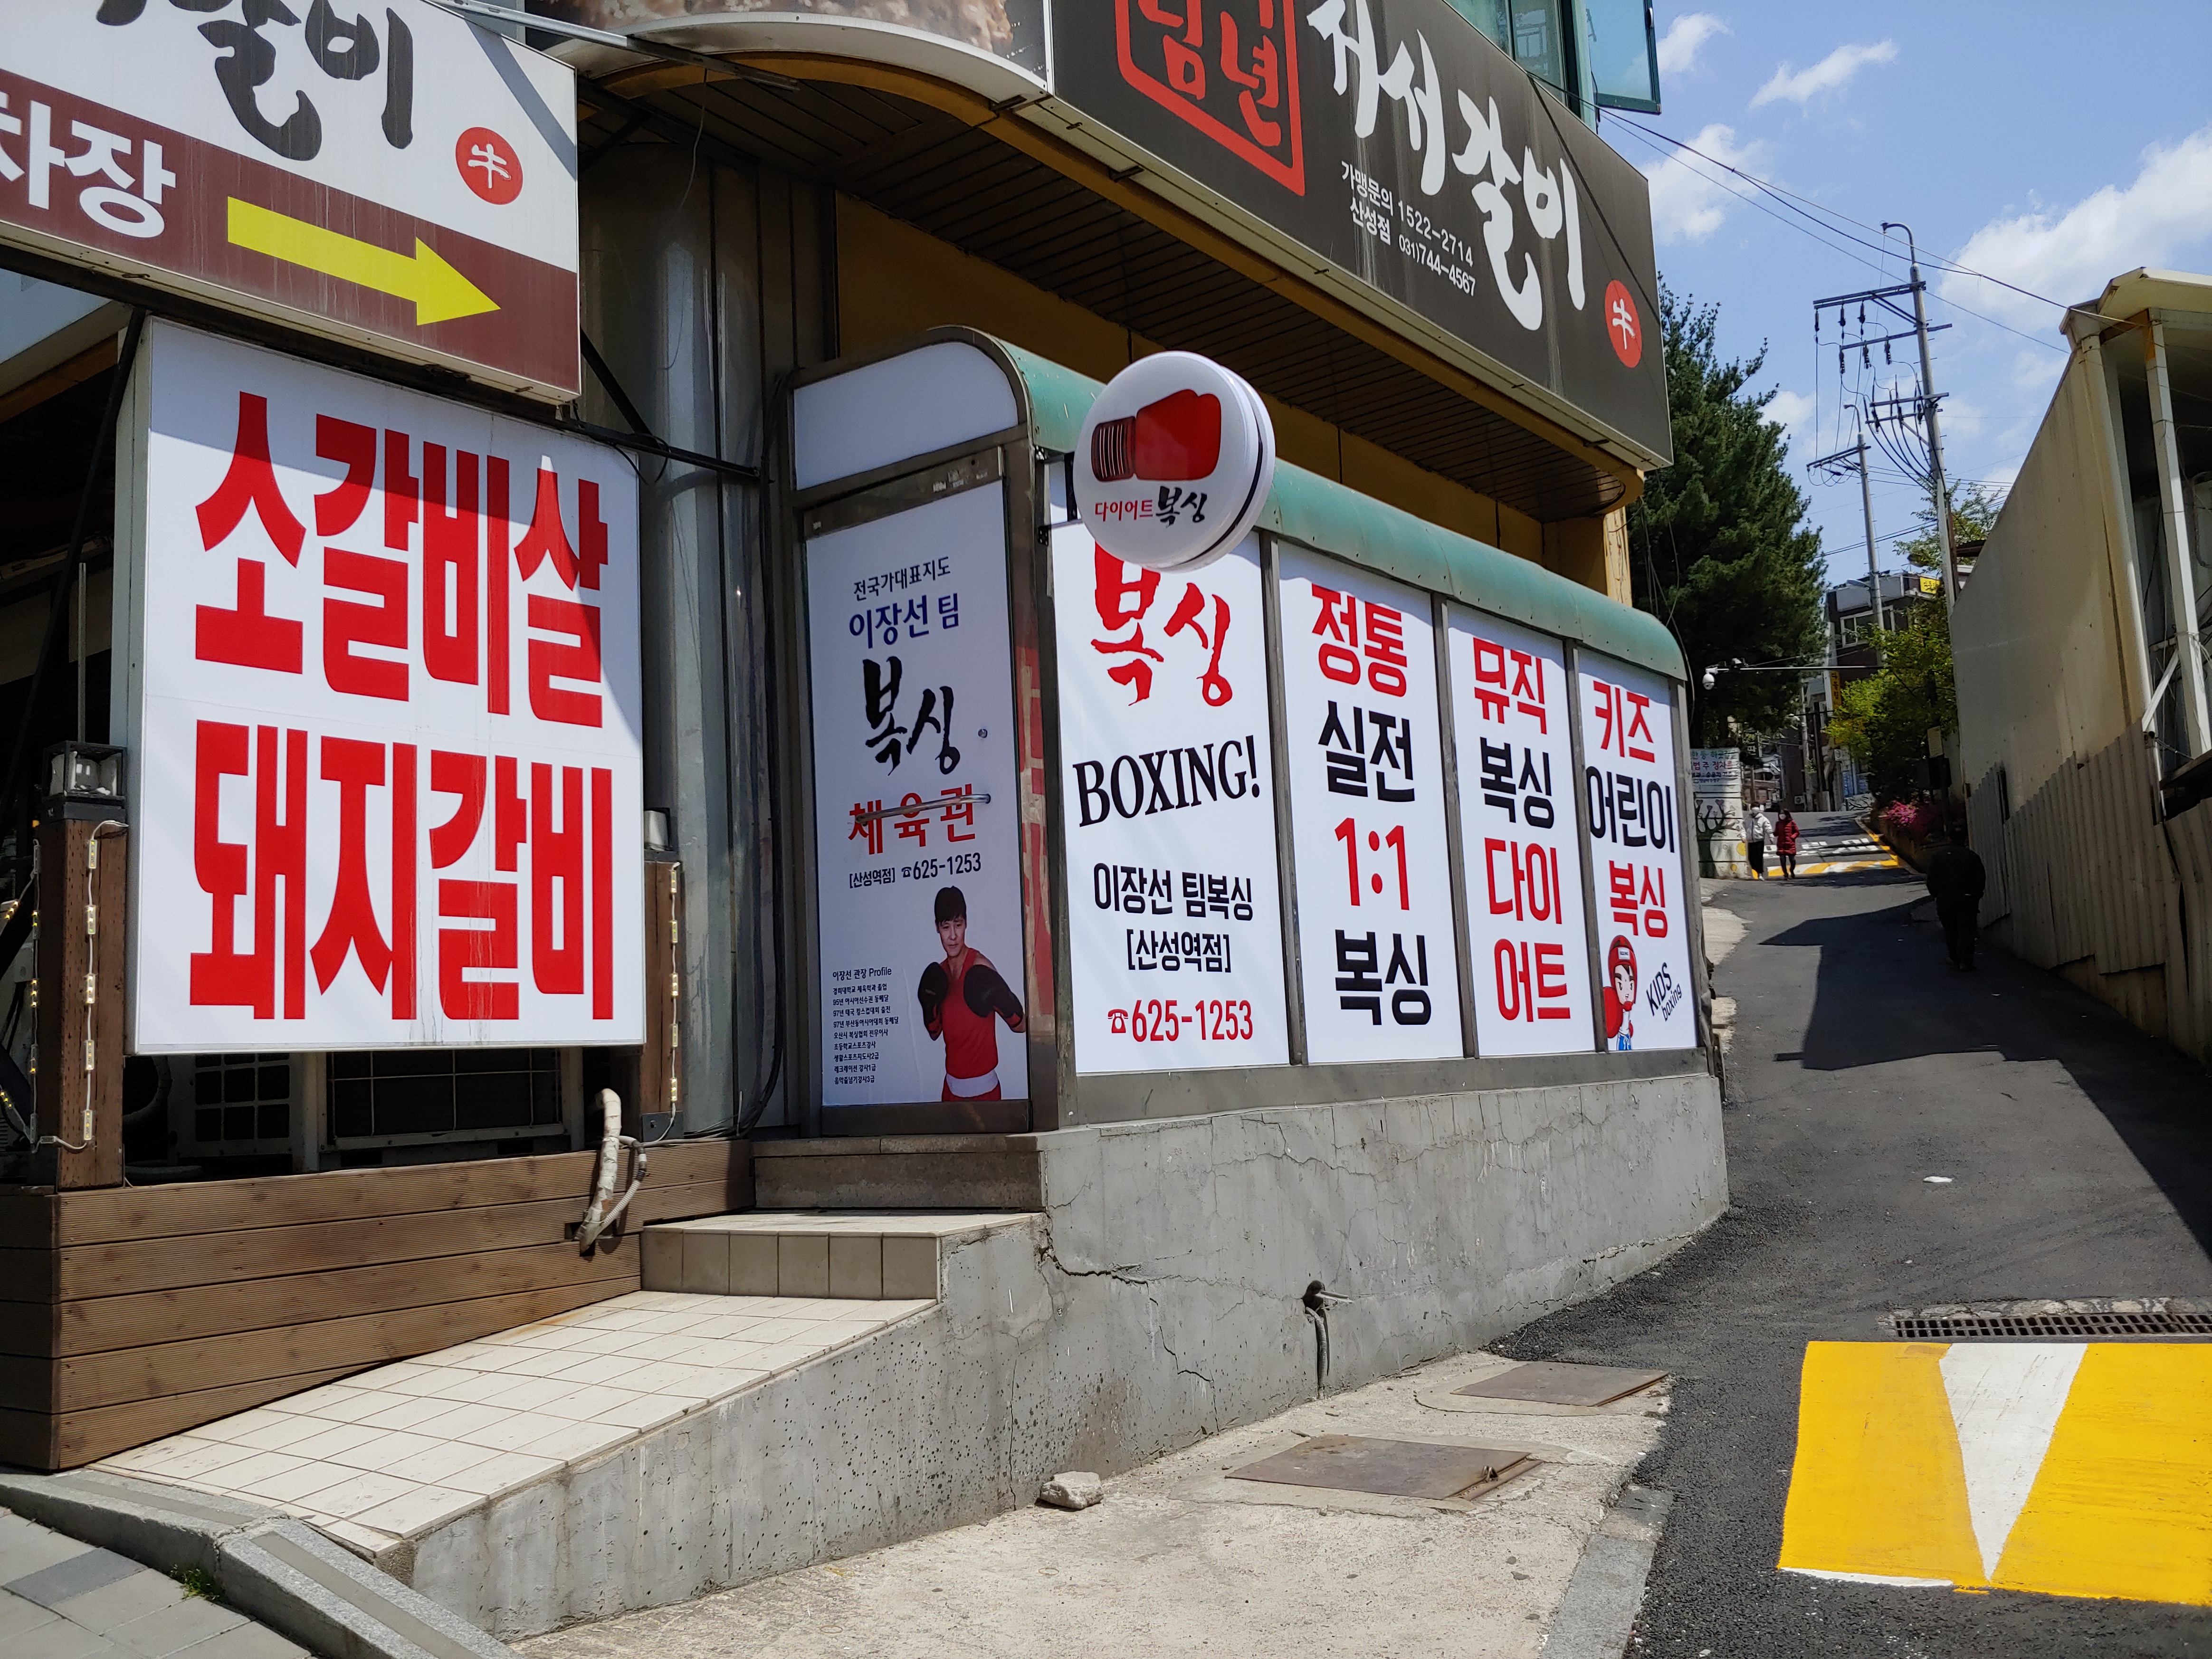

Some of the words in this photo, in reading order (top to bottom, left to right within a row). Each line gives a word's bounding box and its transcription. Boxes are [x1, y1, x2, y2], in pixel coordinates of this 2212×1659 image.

[1341, 160, 1393, 217] 가맹문의
[1398, 200, 1473, 267] 1522-2714
[1350, 197, 1391, 246] 산성점
[1399, 234, 1476, 296] 031)744-4567
[1095, 499, 1153, 522] 다이어트
[1156, 486, 1207, 528] 복싱
[195, 391, 608, 727] 소갈비살
[854, 556, 951, 601] 전국가대표지도
[849, 595, 929, 648] 이장선
[938, 593, 959, 629] 팀
[1091, 541, 1233, 706] 복싱
[1311, 582, 1408, 698] 정통
[863, 656, 960, 776] 복싱
[1472, 637, 1547, 735] 뮤직
[1592, 680, 1656, 763] 키즈
[1072, 735, 1260, 827] BOXING!
[1318, 700, 1415, 803] 실전
[1479, 737, 1555, 830] 복싱
[1585, 766, 1675, 854] 어린이
[190, 719, 613, 1020] 돼지갈비
[849, 867, 895, 888] [산성역점]
[913, 852, 981, 880] 625-1253
[1094, 862, 1173, 915] 이장선
[1182, 871, 1253, 921] 팀복싱
[1334, 817, 1410, 911] 1:1
[1484, 837, 1563, 925] 다이
[1609, 860, 1668, 939] 복싱
[833, 970, 851, 981] 이장선
[854, 969, 867, 979] 관장
[869, 967, 892, 977] Profile
[833, 986, 856, 995] 경희대학교
[857, 984, 876, 992] 체육학과
[1126, 929, 1231, 973] [산성역점]
[1335, 929, 1432, 1026] 복싱
[1494, 937, 1571, 1023] 어트
[1646, 962, 1672, 1016] KIDS
[845, 996, 873, 1005] 아시아선수권
[875, 994, 888, 1002] 동메달
[849, 1030, 868, 1039] 복싱협회
[869, 1029, 888, 1037] 전무이사
[885, 1016, 899, 1025] 동메달
[1132, 999, 1253, 1042] 625-1253
[1661, 983, 1682, 1022] boxing
